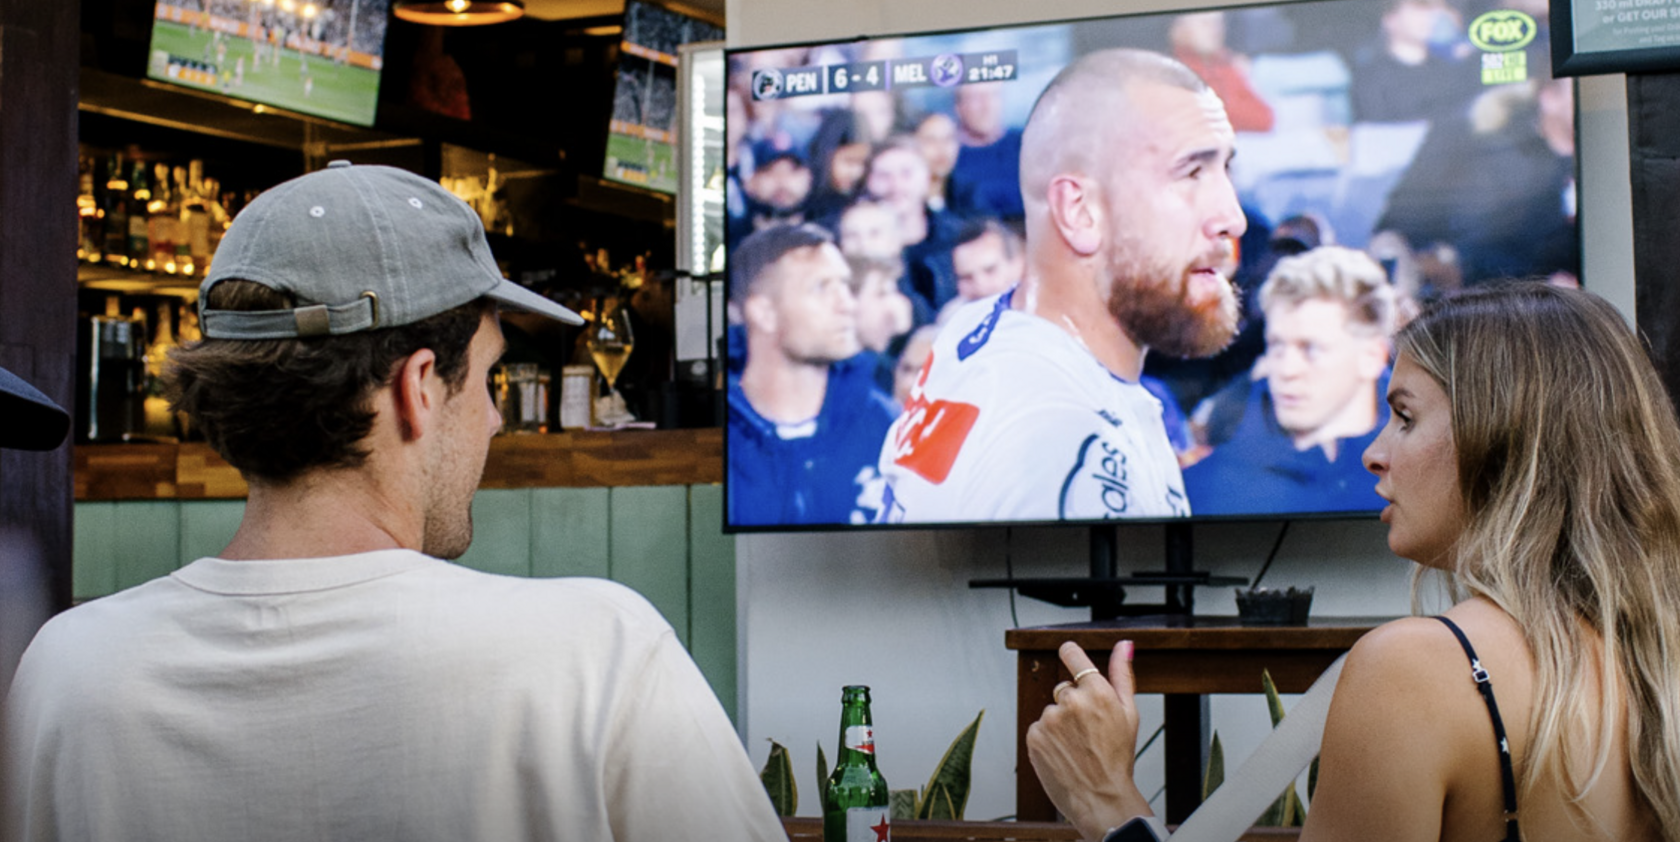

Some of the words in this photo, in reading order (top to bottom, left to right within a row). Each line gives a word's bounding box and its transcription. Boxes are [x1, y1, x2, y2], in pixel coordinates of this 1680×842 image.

[1595, 0, 1616, 11] 330
[1618, 0, 1633, 8] ml
[1602, 15, 1615, 24] or
[1617, 10, 1640, 22] GET
[1641, 7, 1668, 21] OUR
[1481, 20, 1523, 43] FOX
[982, 54, 998, 66] H1
[786, 73, 818, 93] PEN
[834, 69, 848, 88] 6
[866, 66, 878, 85] 4
[894, 64, 926, 83] MEL
[969, 64, 1014, 81] 21:47
[1092, 441, 1129, 519] ales
